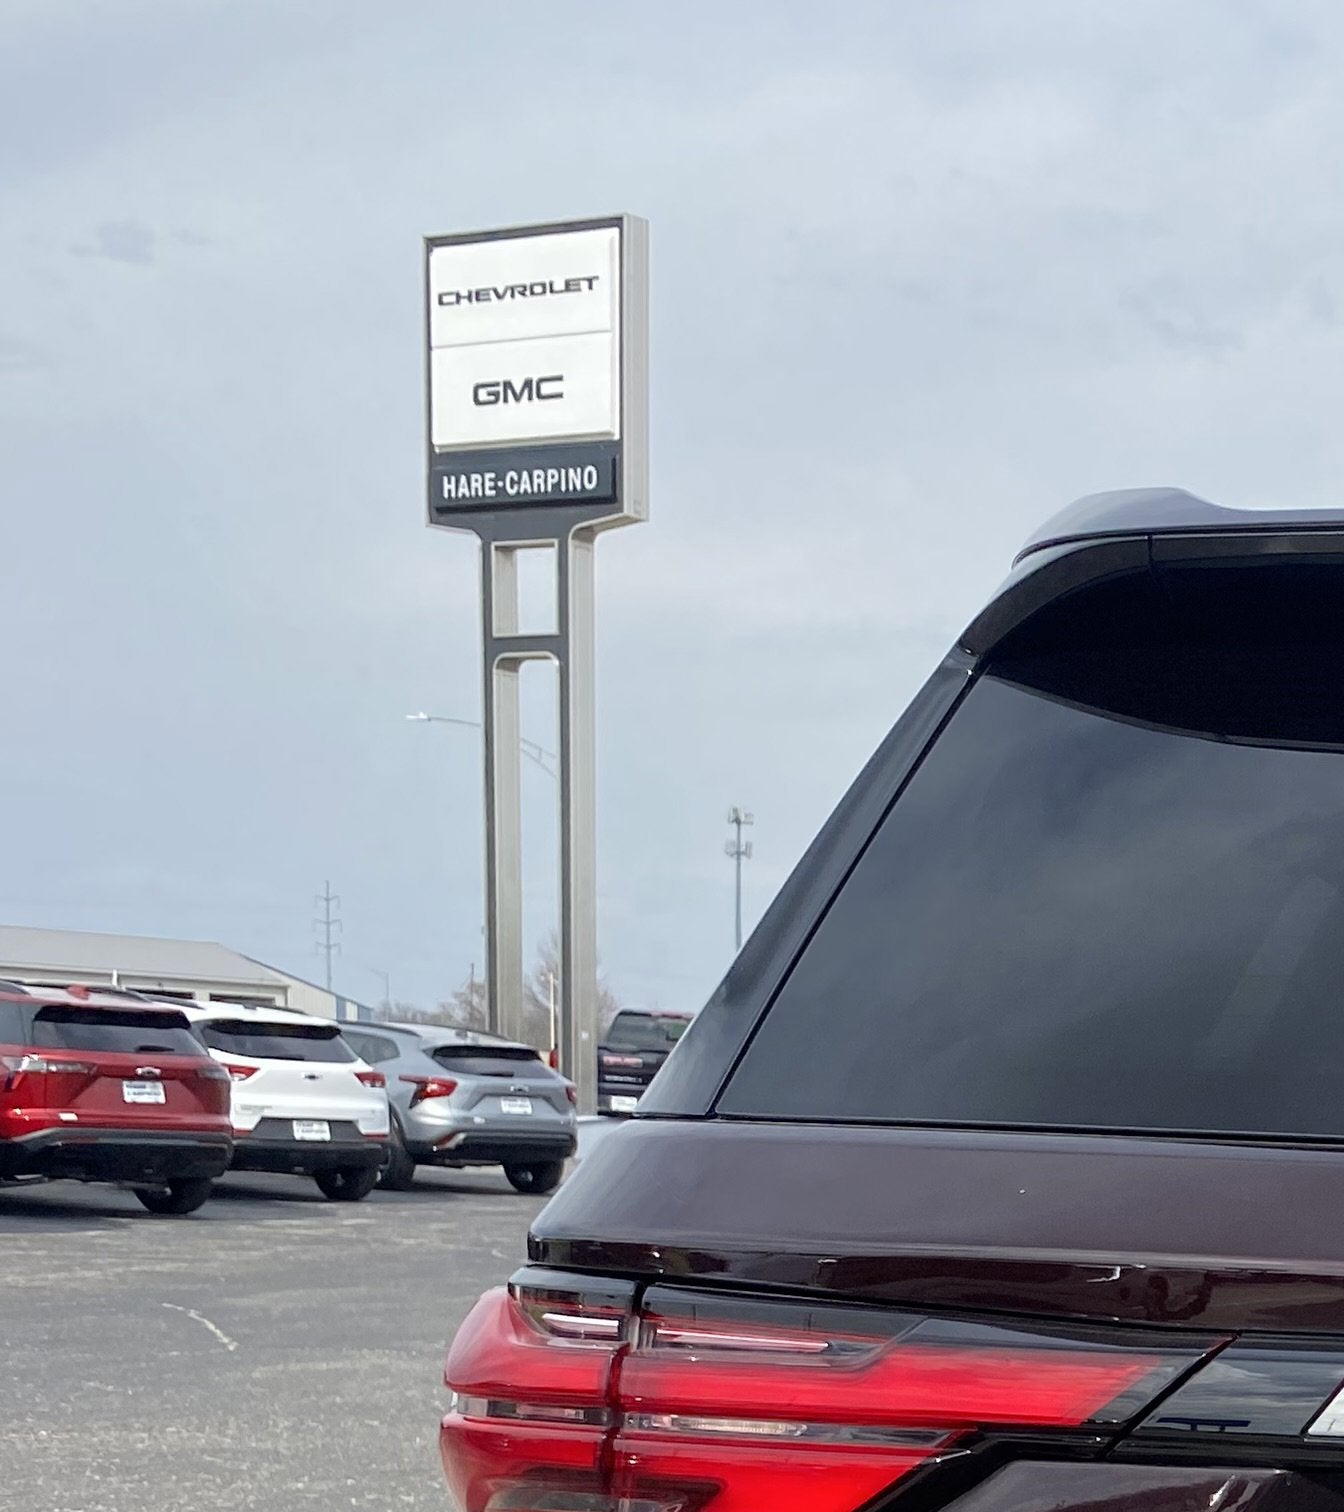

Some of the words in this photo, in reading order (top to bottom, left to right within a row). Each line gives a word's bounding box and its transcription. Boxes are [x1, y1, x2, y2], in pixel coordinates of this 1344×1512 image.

[438, 276, 599, 306] CHEVROLET
[472, 375, 564, 406] GMC
[442, 465, 598, 499] HARE-CARPINO
